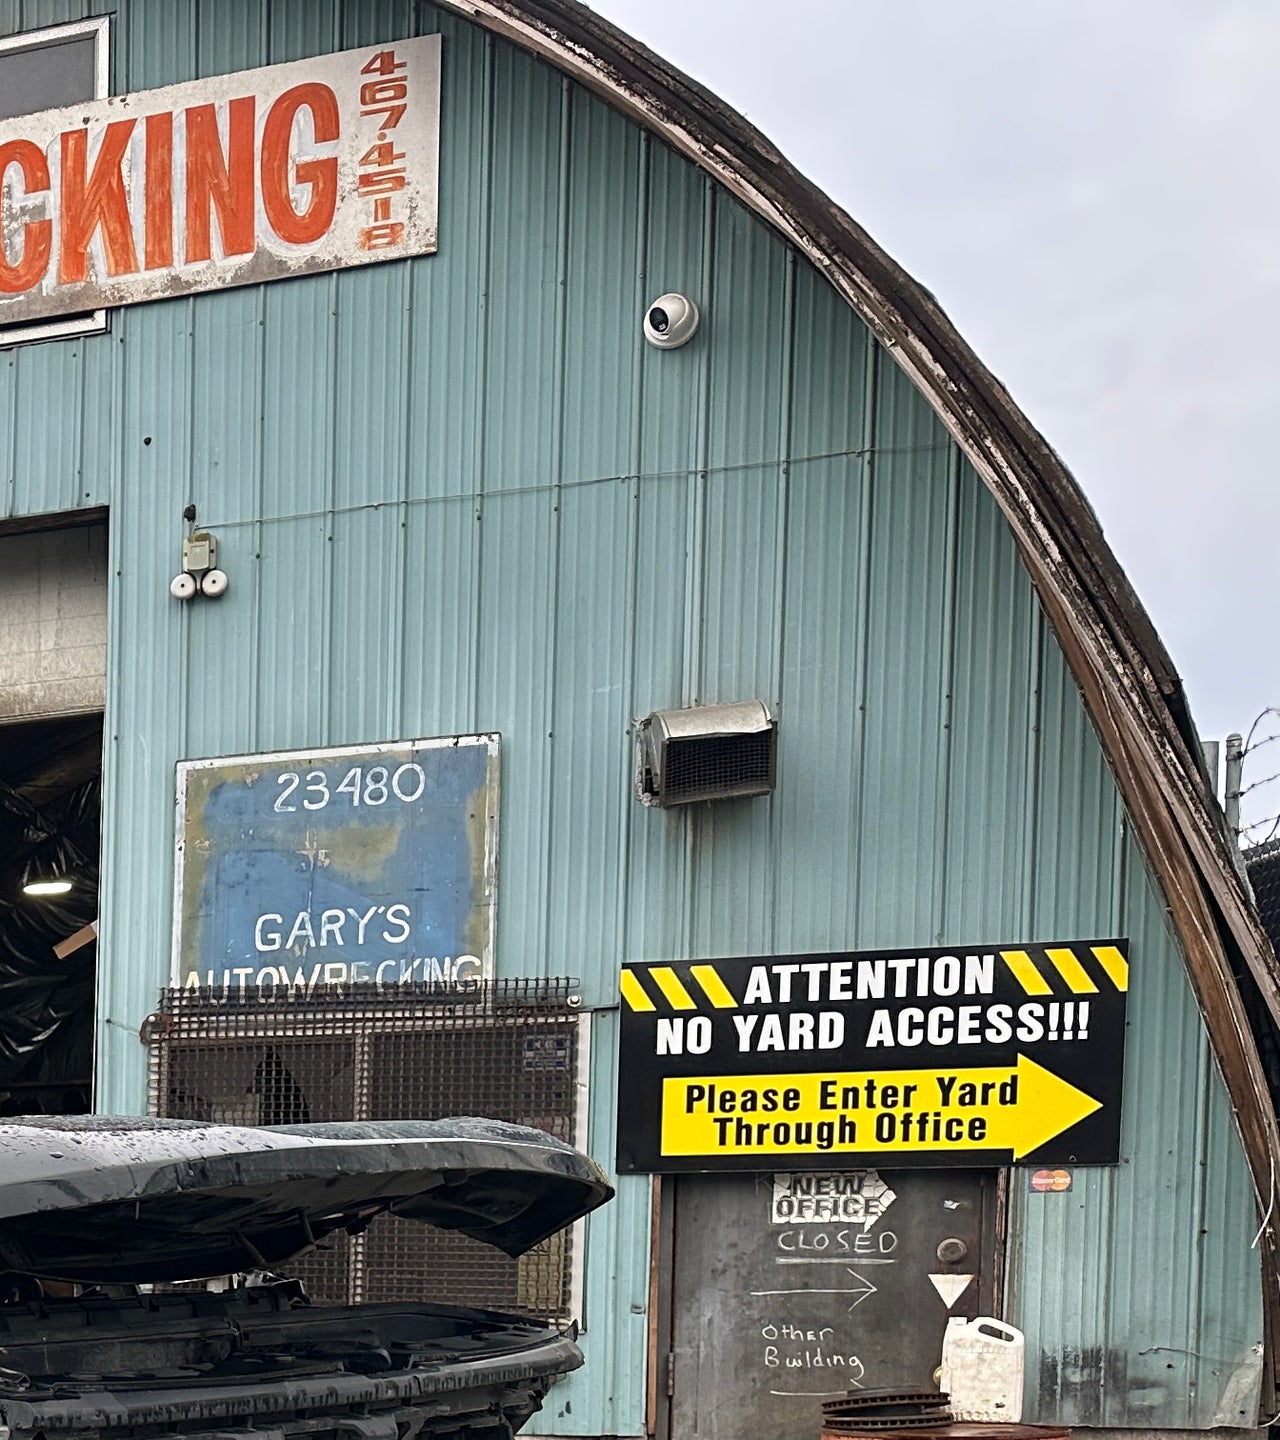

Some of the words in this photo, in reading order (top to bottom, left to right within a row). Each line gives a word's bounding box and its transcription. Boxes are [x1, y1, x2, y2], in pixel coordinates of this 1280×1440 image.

[273, 763, 427, 814] 23480
[254, 904, 412, 953] GARY'S
[743, 955, 995, 1005] ATTENTION
[655, 1014, 713, 1056] NO
[732, 1010, 846, 1053] YARD
[865, 1001, 1091, 1048] ACCESS!!!
[684, 1083, 801, 1114] Please
[819, 1079, 918, 1110] Enter
[936, 1074, 1019, 1106] Yard
[713, 1117, 857, 1150] Through
[874, 1110, 987, 1143] Office
[790, 1173, 864, 1196] NEW
[776, 1195, 880, 1218] OFFICE
[777, 1230, 898, 1254] CLOSED
[764, 1346, 866, 1380] Building
